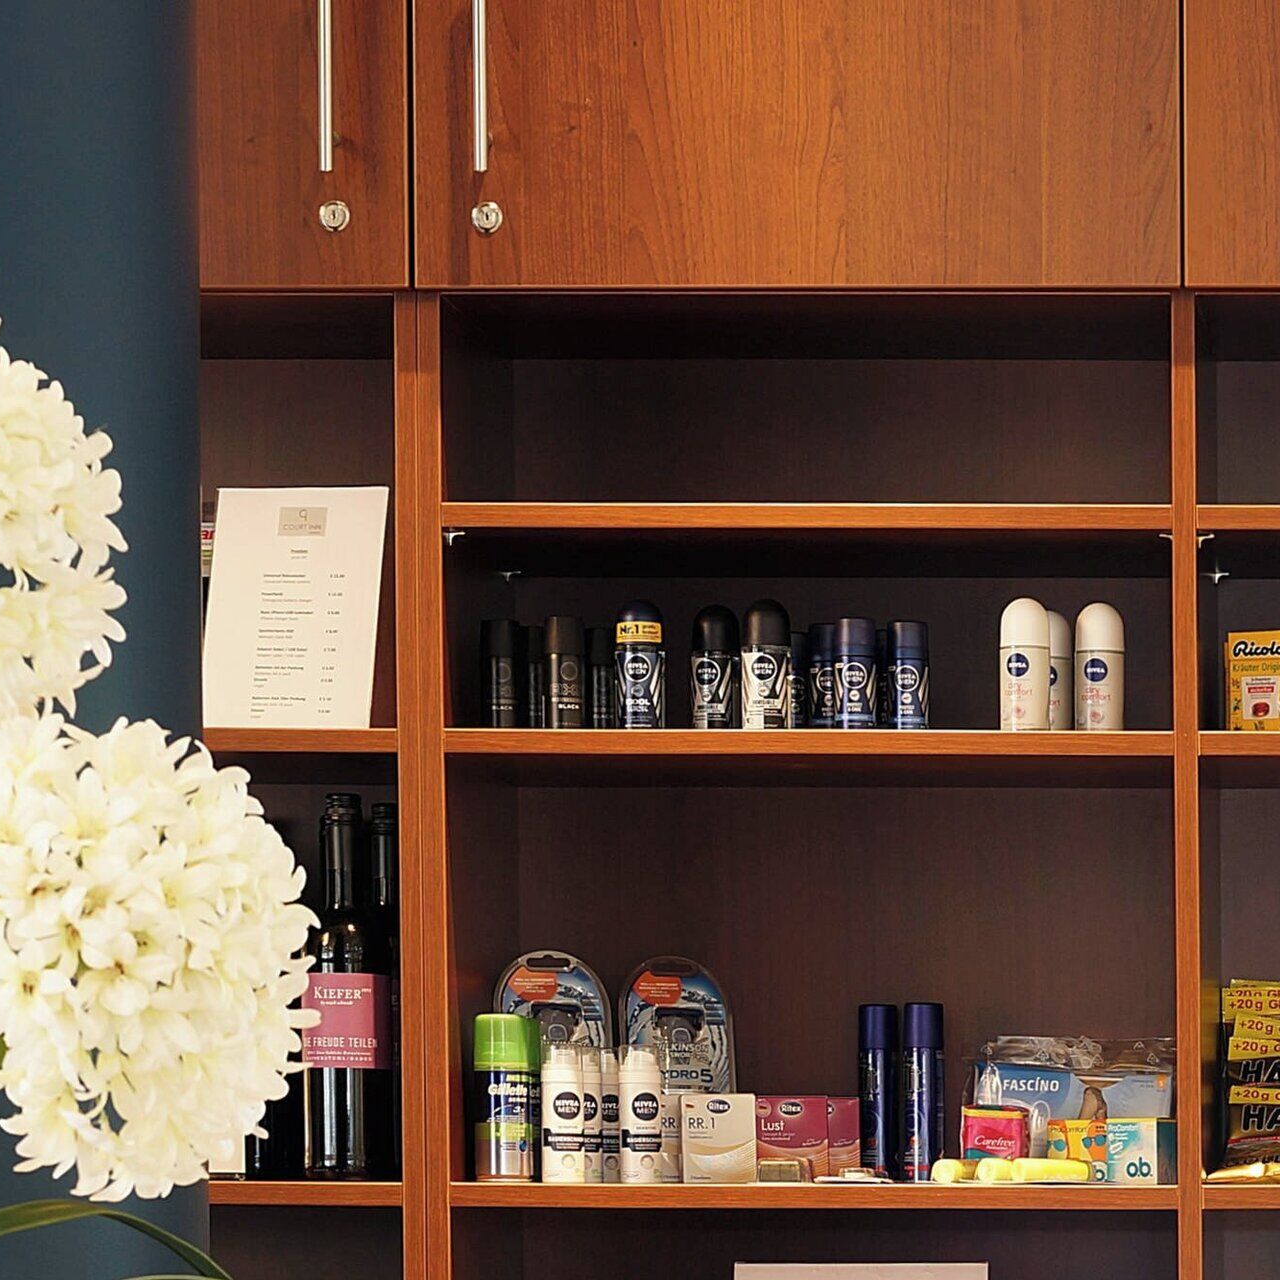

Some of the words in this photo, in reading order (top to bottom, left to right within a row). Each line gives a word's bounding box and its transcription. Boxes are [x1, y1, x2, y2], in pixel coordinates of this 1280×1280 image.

[1232, 662, 1259, 672] Kräuter
[314, 986, 362, 999] KIEFER
[1229, 1000, 1252, 1009] +20
[1239, 1020, 1265, 1031] +20
[313, 1037, 345, 1048] FREUDE
[348, 1037, 377, 1048] TEILEN
[700, 1069, 714, 1083] 5
[1234, 1090, 1259, 1099] +20
[708, 1101, 730, 1112] Ritex
[781, 1103, 802, 1113] Ritex
[761, 1119, 785, 1131] Lust
[974, 1135, 1017, 1147] Carefree
